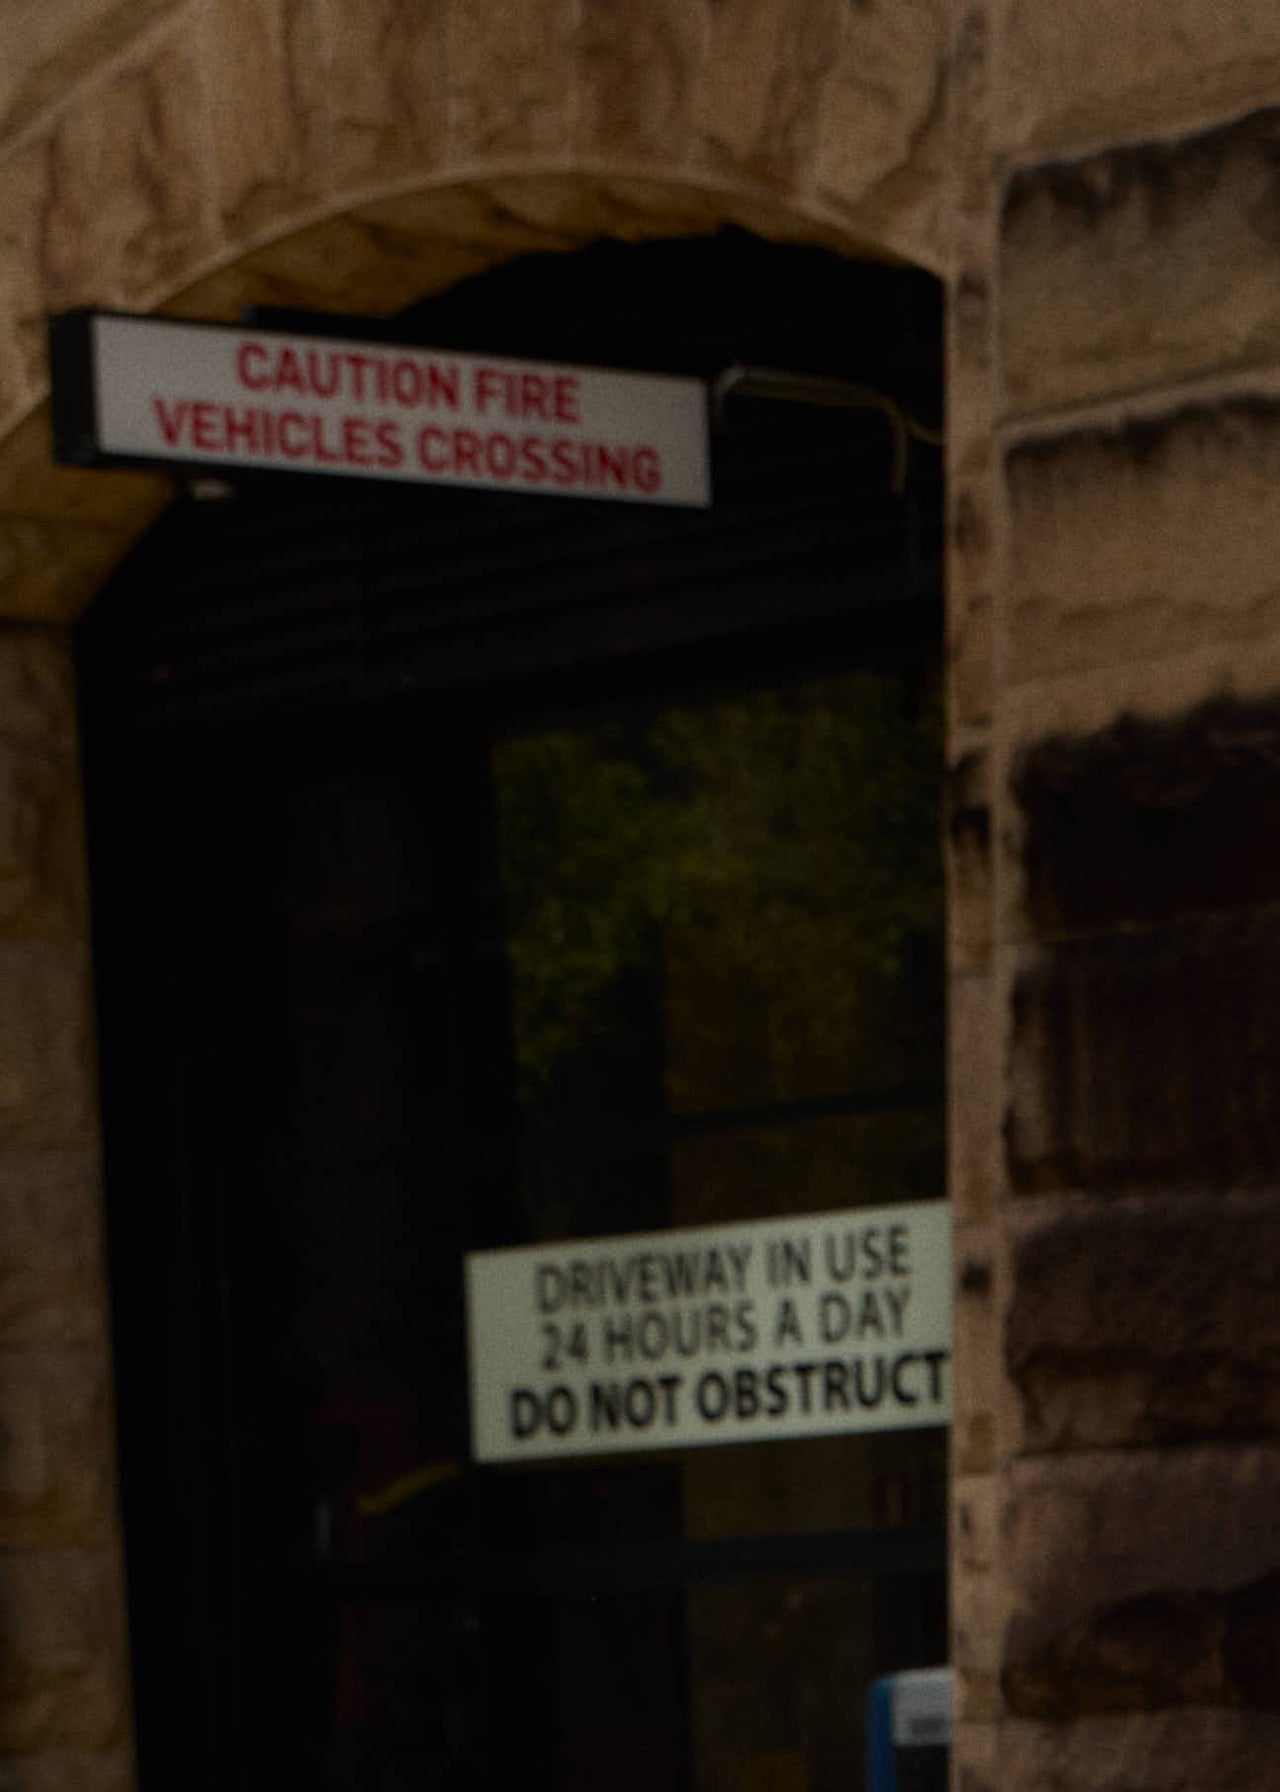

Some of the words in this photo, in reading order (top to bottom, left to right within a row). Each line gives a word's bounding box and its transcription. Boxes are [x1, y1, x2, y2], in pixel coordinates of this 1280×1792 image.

[238, 343, 459, 411] CAUTION
[475, 368, 580, 423] FIRE
[154, 398, 403, 468] VEHICLES
[417, 423, 662, 494] CROSSING
[538, 1247, 752, 1313] DRIVEWAY
[769, 1240, 811, 1287] IN
[827, 1225, 910, 1281] USE
[540, 1323, 590, 1371] 24
[605, 1303, 756, 1363] HOURS
[773, 1298, 804, 1348] A
[821, 1288, 909, 1343] DAY
[512, 1389, 576, 1438] DO
[589, 1375, 682, 1433] NOT
[697, 1351, 948, 1421] OBSTRUCT
